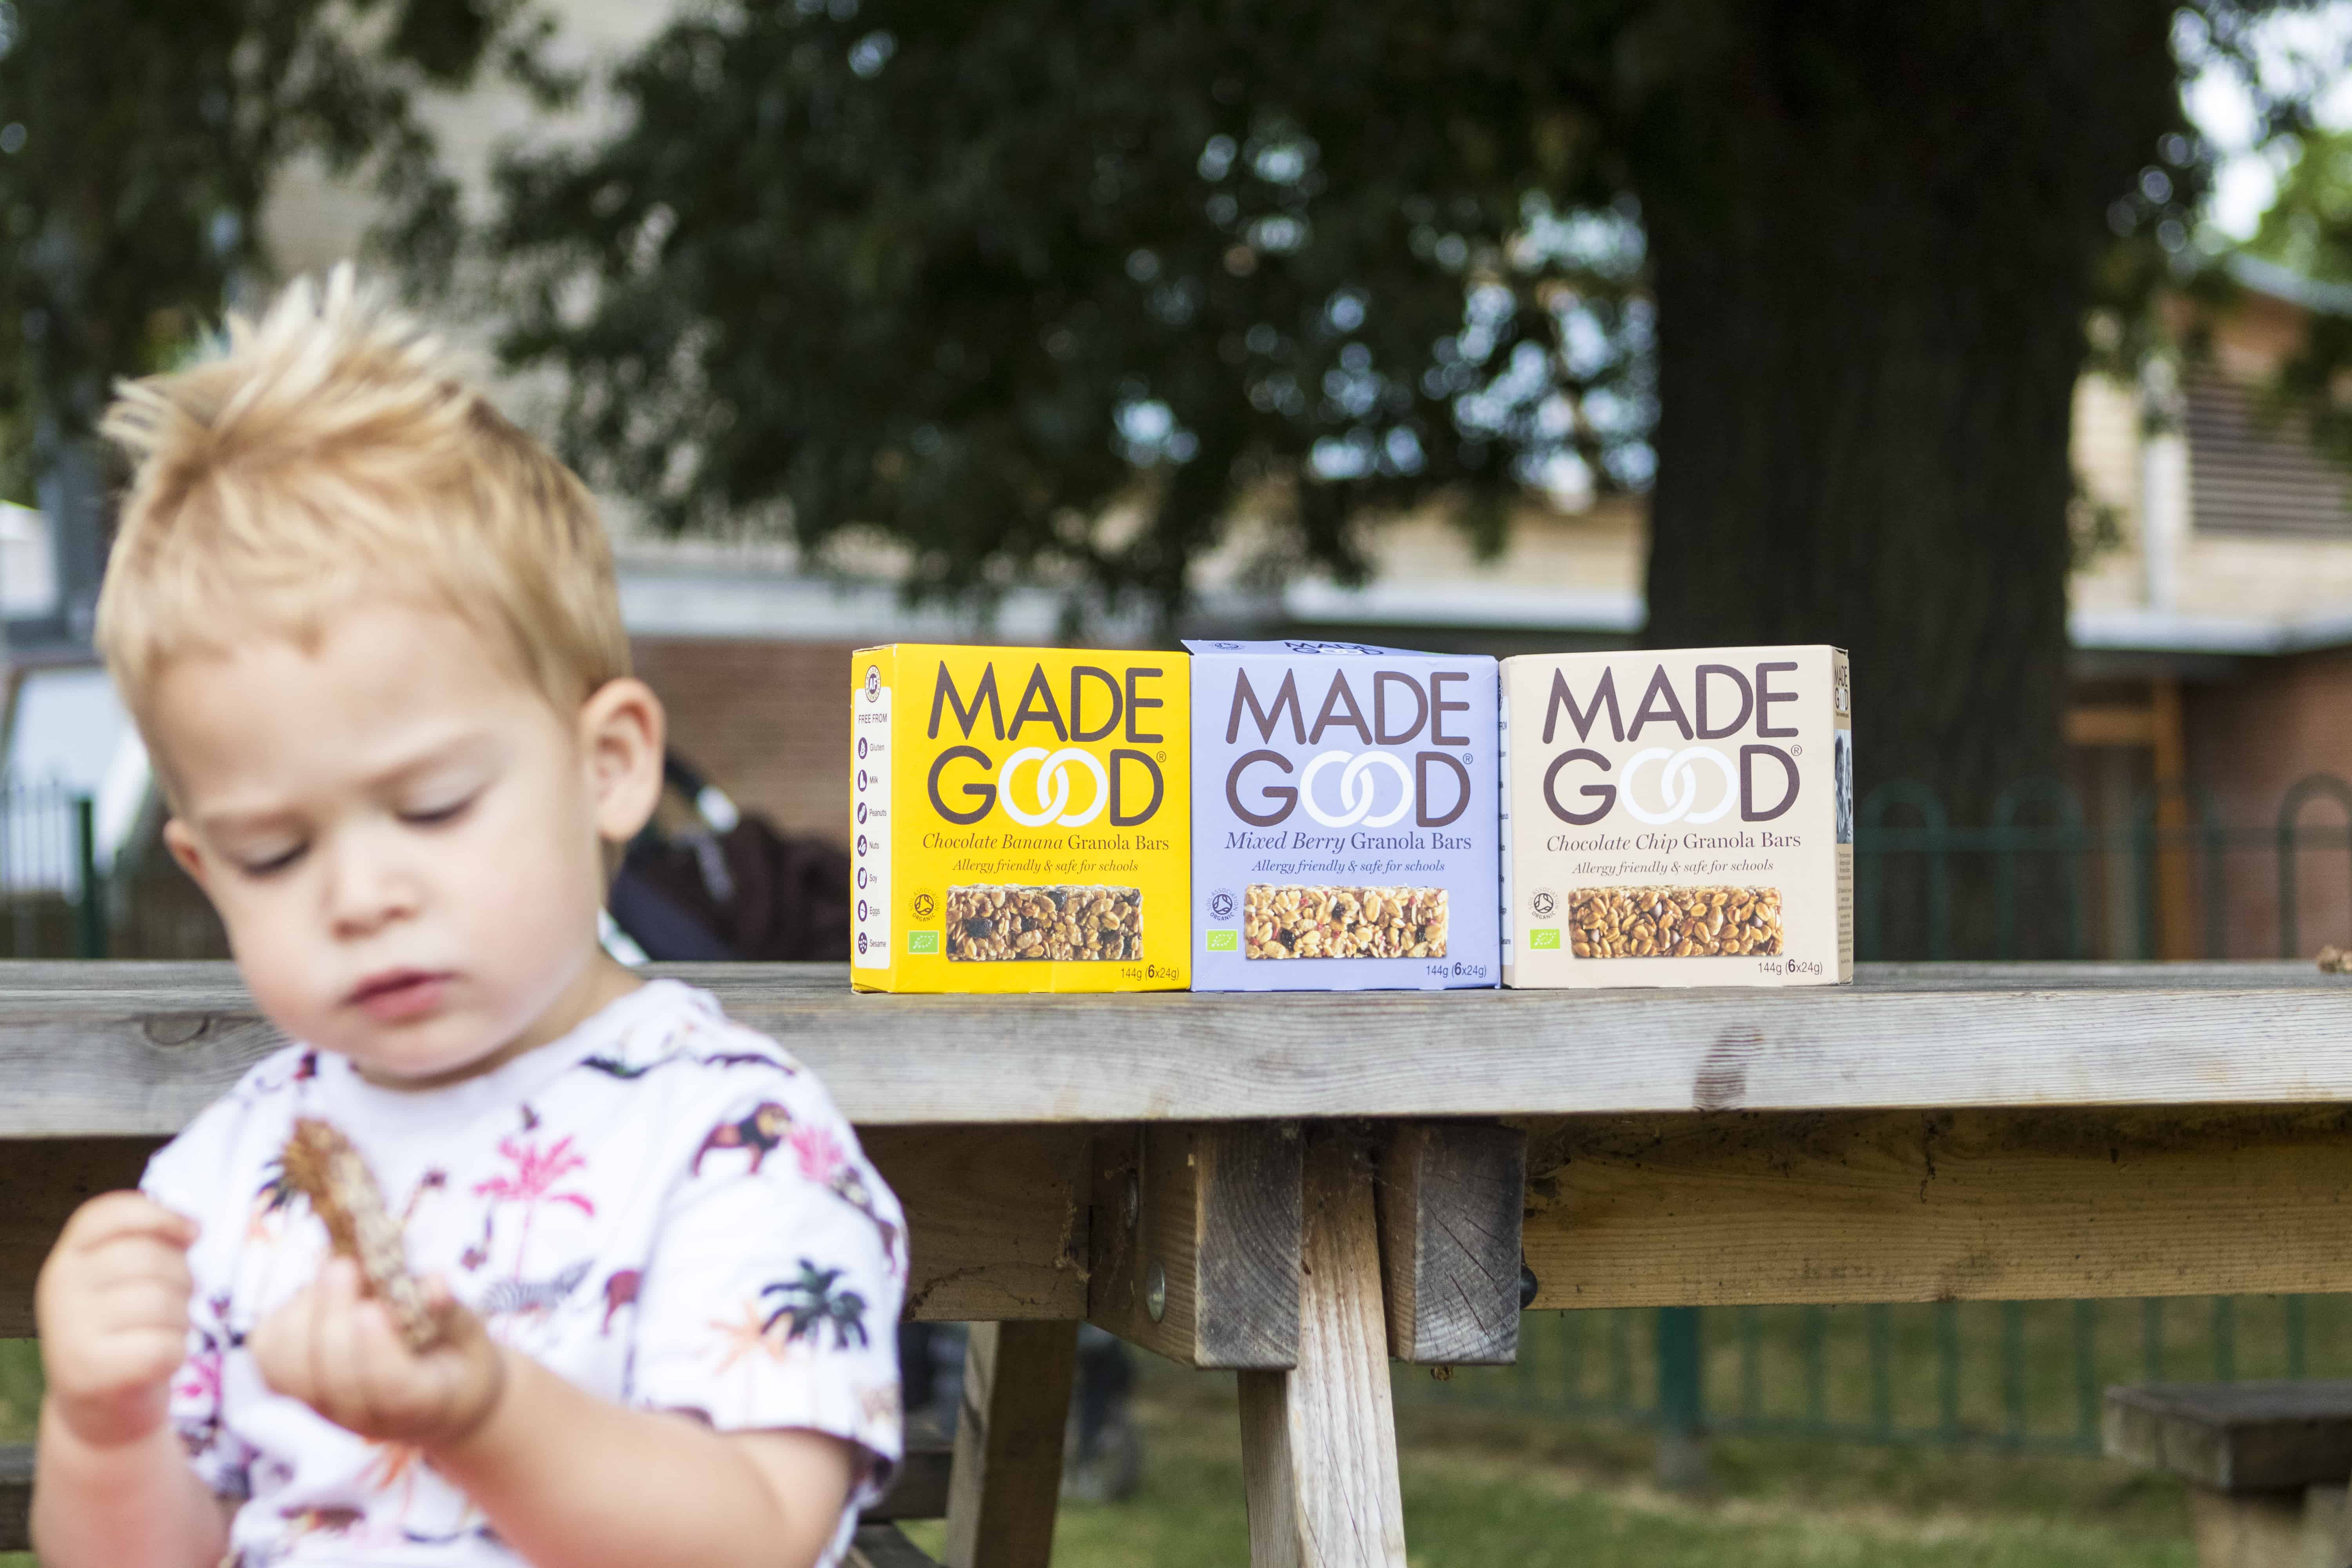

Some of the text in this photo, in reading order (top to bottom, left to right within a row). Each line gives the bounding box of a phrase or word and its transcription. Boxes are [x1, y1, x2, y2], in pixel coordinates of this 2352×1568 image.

[1284, 641, 1369, 650] MADE
[869, 677, 877, 690] AF
[1835, 665, 1848, 687] MADE
[927, 660, 1164, 744] MADE
[1225, 667, 1470, 746] MADE
[1542, 661, 1799, 744] MADE
[858, 713, 887, 724] FREE FROM
[870, 743, 884, 751] Gluten
[869, 841, 880, 849] Nuts
[923, 832, 1169, 850] Chocolate Banana Granola Bars
[1224, 831, 1471, 855] Mixed Berry Granola Bars
[1547, 831, 1800, 854] Chocolate Chip Granola Bars
[952, 858, 1138, 875] Allergy friendly & safe for schools
[1251, 859, 1445, 874] Allergy friendly & safe for schools
[1572, 859, 1773, 876] Allergy friendly & safe for schools
[869, 873, 878, 884] Soy
[914, 887, 940, 911] ASSOCIATION
[1211, 887, 1238, 911] ASSOCIATION
[869, 906, 880, 916] Eggs
[912, 913, 935, 922] ORGANIC
[1210, 912, 1234, 921] ORGANIC
[1532, 911, 1556, 919] ORGANIC
[869, 939, 886, 947] Sesame
[1121, 964, 1179, 981] 144g (6x24g)
[1426, 962, 1486, 978] 144g (6x24g)
[1758, 959, 1822, 976] 144g (6x24g)
